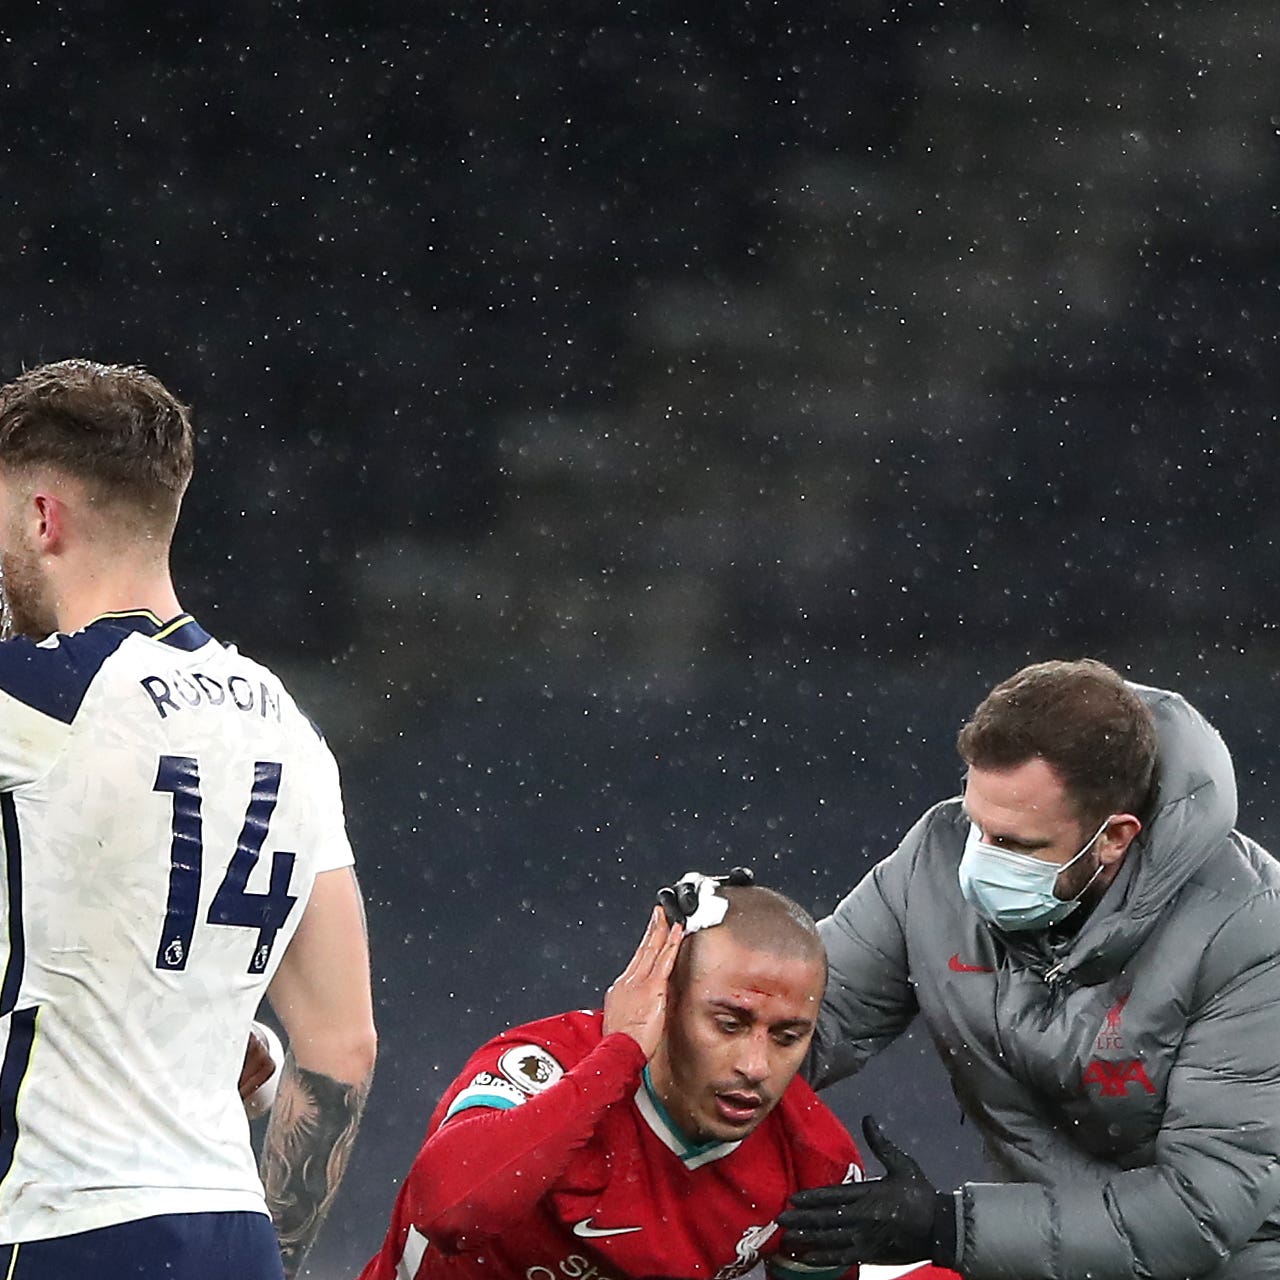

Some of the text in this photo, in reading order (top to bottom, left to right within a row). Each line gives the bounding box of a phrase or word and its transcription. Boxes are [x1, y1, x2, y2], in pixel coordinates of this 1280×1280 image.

[140, 671, 283, 724] RODON
[153, 755, 298, 974] 14
[1079, 1060, 1158, 1097] AXA
